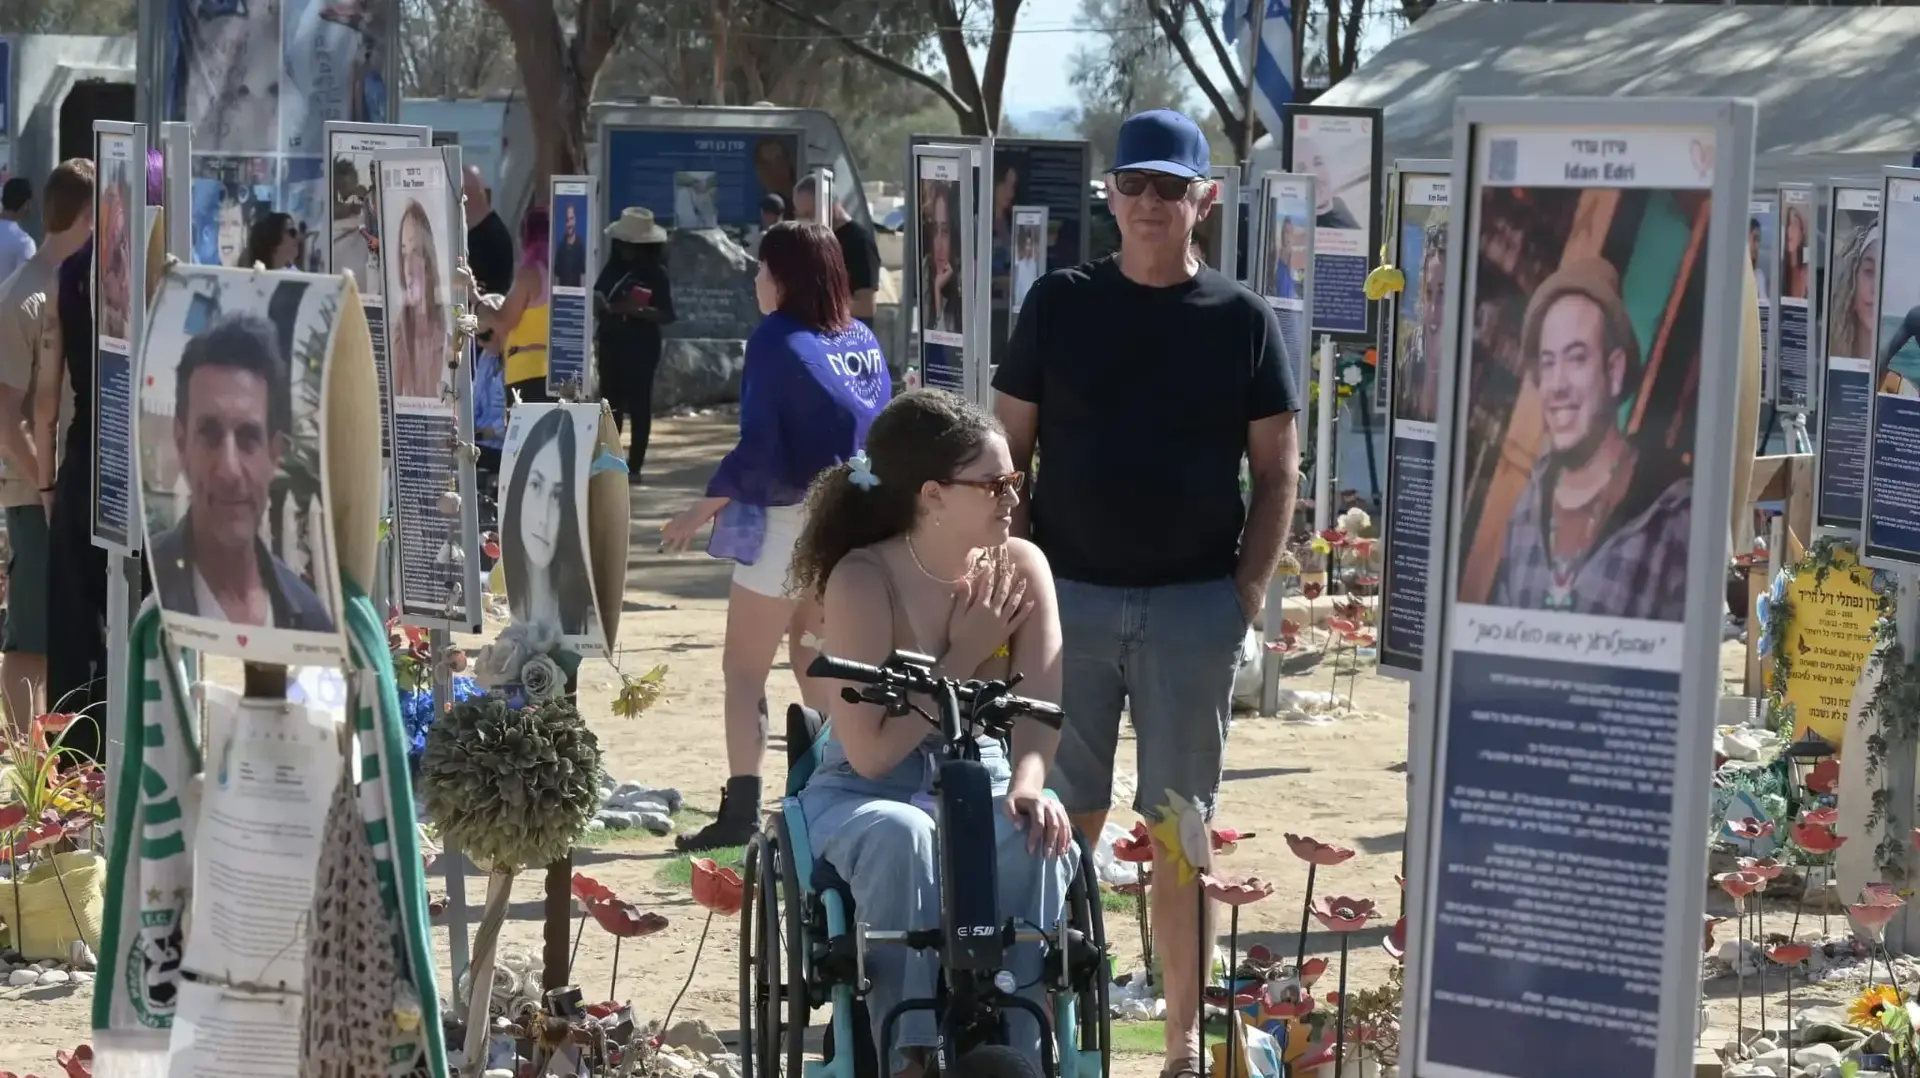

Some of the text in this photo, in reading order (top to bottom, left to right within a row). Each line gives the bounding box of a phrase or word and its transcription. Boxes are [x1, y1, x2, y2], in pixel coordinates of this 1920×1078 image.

[1564, 162, 1636, 180] Idan Edri
[826, 348, 882, 377] NOVA
[1836, 592, 1863, 608] נפתלי
[1820, 695, 1838, 707] נזכור
[1831, 711, 1841, 720] לא
